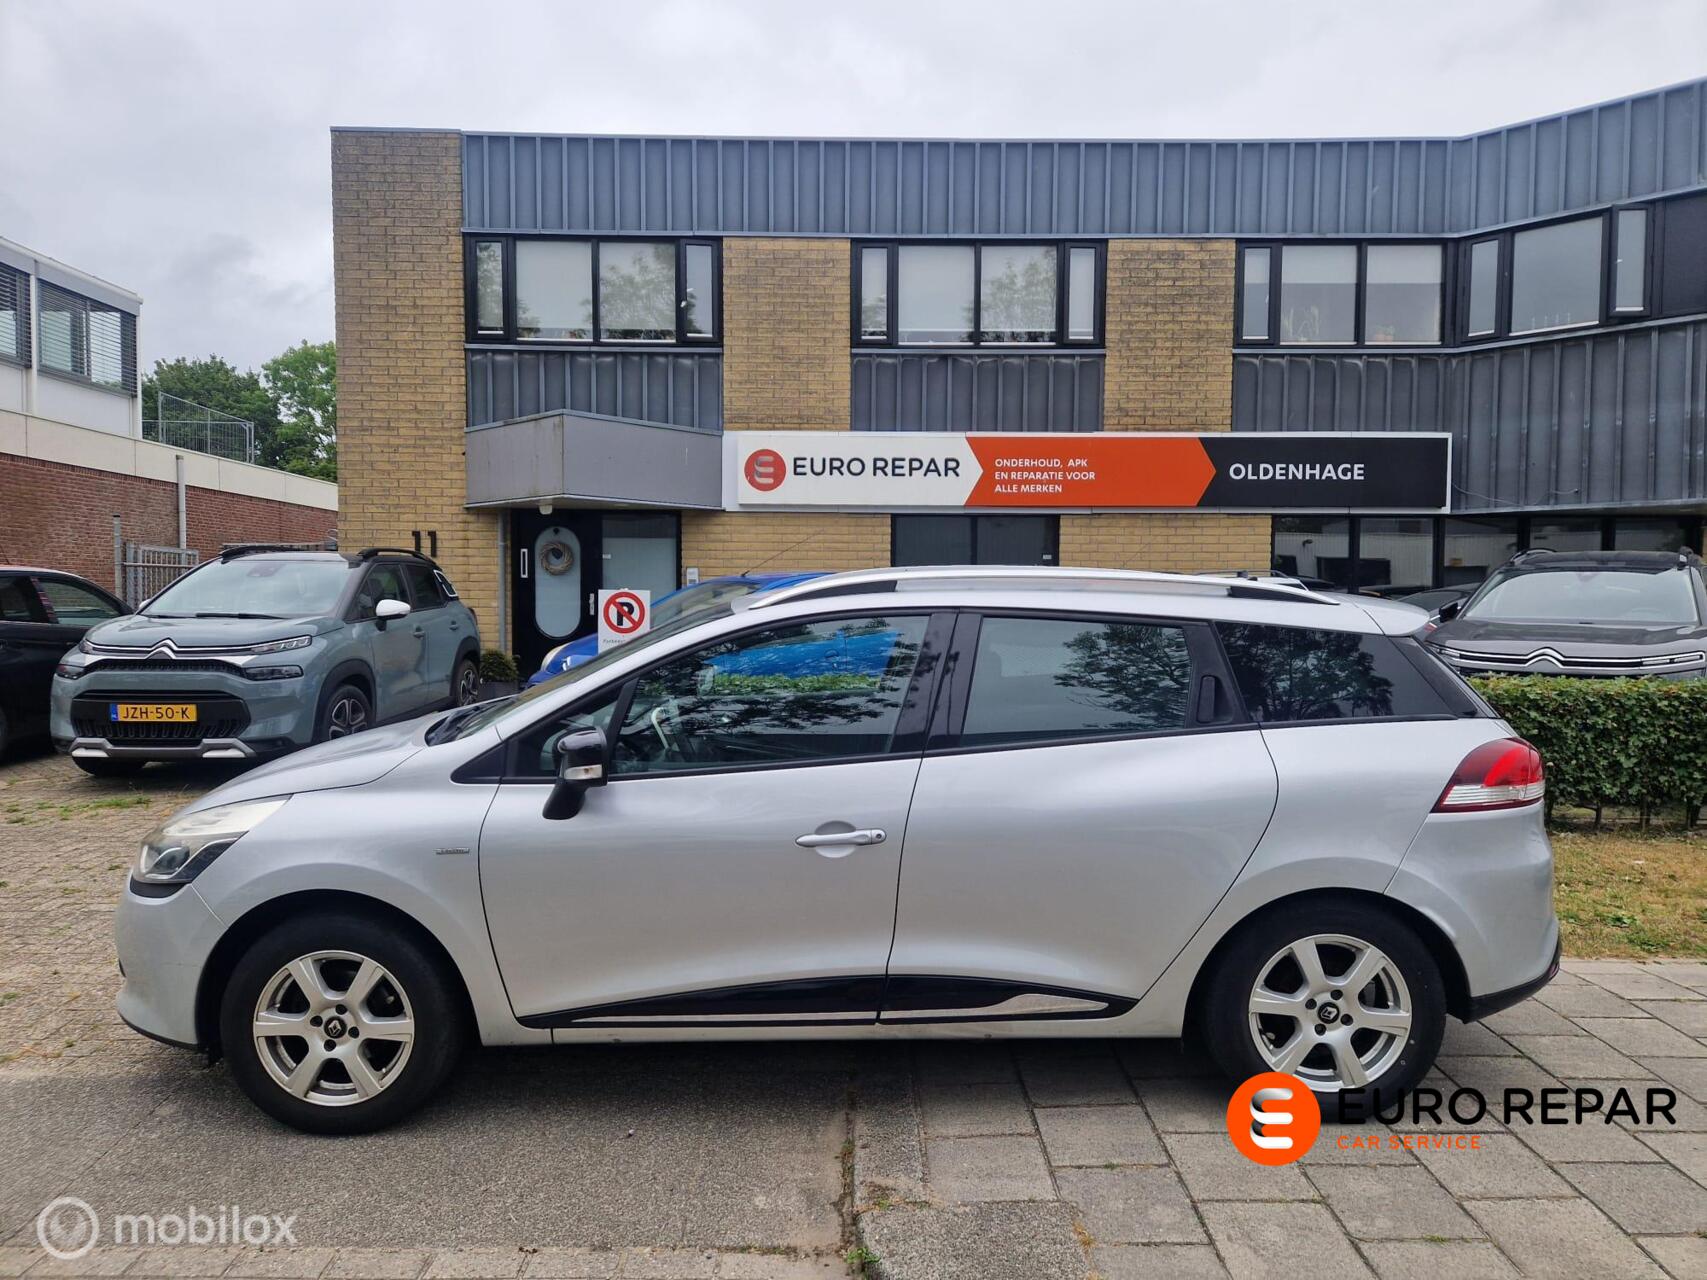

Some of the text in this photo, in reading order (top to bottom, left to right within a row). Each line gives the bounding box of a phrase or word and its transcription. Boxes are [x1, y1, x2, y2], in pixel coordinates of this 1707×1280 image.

[793, 457, 960, 477] EURO REPAR
[994, 458, 1088, 468] ONDERHOUD, APK
[994, 471, 1096, 480] EN REPARATIE VOOR
[1229, 463, 1365, 481] OLDENHAGE
[994, 484, 1063, 493] ALLE MERKEN
[411, 530, 437, 557] 11
[122, 706, 190, 719] JZH-50-K
